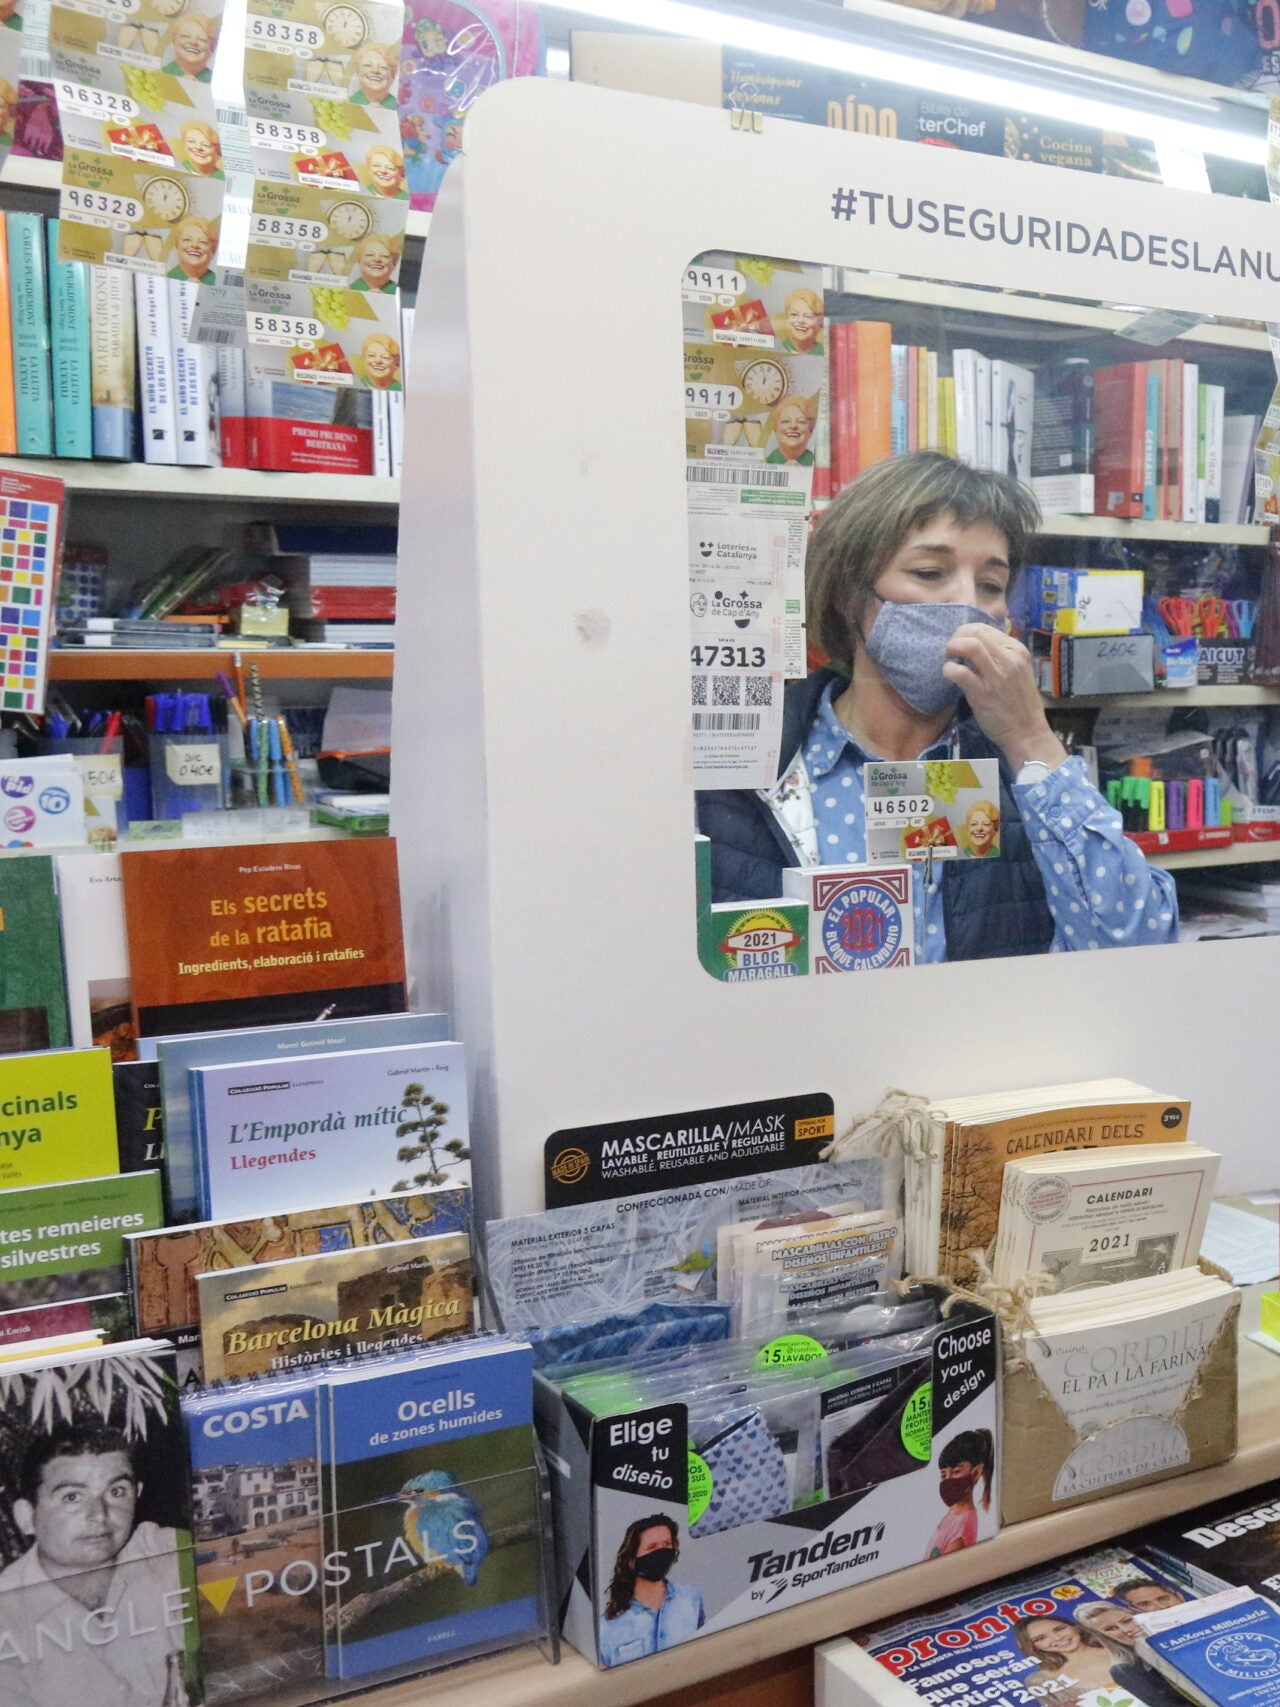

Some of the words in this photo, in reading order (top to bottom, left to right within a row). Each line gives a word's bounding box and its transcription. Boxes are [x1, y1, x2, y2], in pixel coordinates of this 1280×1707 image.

[252, 20, 318, 46] 58358
[62, 84, 133, 114] 96328
[257, 96, 292, 109] Grossa
[255, 122, 320, 144] 58358
[917, 116, 987, 138] terChef
[1039, 136, 1093, 155] Cocina
[1039, 152, 1093, 169] vegana
[68, 190, 137, 218] 96328
[257, 218, 321, 239] 58358
[24, 266, 35, 327] PUIGDEMONT
[66, 270, 76, 331] PUIGDEMONT
[254, 317, 318, 336] 58358
[716, 551, 758, 561] Catalunya
[711, 609, 721, 617] de
[722, 609, 738, 619] Cap
[738, 608, 761, 620] d'Any
[722, 597, 763, 610] Grossa
[690, 645, 767, 668] 47313
[1198, 648, 1246, 665] AICUT
[873, 799, 930, 814] 46502
[210, 899, 239, 917] Els
[243, 887, 329, 915] secrets
[827, 906, 844, 923] EL
[841, 889, 896, 919] POPULAR
[209, 931, 231, 949] de
[235, 929, 250, 946] la
[255, 916, 334, 945] ratafia
[743, 931, 777, 948] 2021
[840, 906, 885, 953] 2021
[177, 956, 253, 976] Ingredients,
[252, 950, 314, 969] elaboració
[315, 951, 322, 963] i
[322, 948, 366, 964] ratafies
[742, 948, 780, 966] BLOC
[825, 931, 854, 968] BLOQUE
[853, 925, 899, 971] CALENDARIO
[727, 964, 795, 983] MARAGALL
[1, 1091, 79, 1117] cinals
[228, 1110, 347, 1145] L'Empordà
[354, 1104, 408, 1129] mític
[601, 1114, 786, 1158] MASCARILLA/MASK
[797, 1124, 826, 1138] SPORT
[602, 1153, 648, 1170] LAVABLE
[656, 1142, 720, 1160] REUTILIZABLE
[721, 1139, 729, 1150] Y
[730, 1131, 786, 1150] REGULABLE
[1006, 1126, 1094, 1155] CALENDARI
[1101, 1123, 1145, 1142] DELS
[230, 1147, 318, 1171] Llegendes
[659, 1155, 706, 1172] REUSABLE
[706, 1150, 729, 1165] AND
[730, 1141, 786, 1161] ADJUSTABLE
[738, 1194, 771, 1206] MATERIAL
[771, 1189, 800, 1201] INTERIOR
[1086, 1186, 1154, 1206] CALENDARI
[0, 1226, 31, 1245] tes
[37, 1210, 145, 1240] remeieres
[510, 1234, 547, 1248] MATERIAL
[548, 1229, 583, 1241] EXTERIOR
[589, 1222, 616, 1234] CAPAS
[0, 1241, 102, 1269] silvestres
[771, 1238, 843, 1261] MASCARILLAS
[844, 1233, 867, 1249] CON
[867, 1226, 899, 1243] FILTRO
[1088, 1233, 1132, 1253] 2021
[783, 1252, 829, 1270] DISEÑOS
[225, 1316, 359, 1357] Barcelona
[368, 1297, 461, 1332] Màgica
[271, 1347, 343, 1371] Històries
[345, 1344, 354, 1358] i
[356, 1332, 424, 1354] llegendes
[763, 1348, 782, 1364] 15
[782, 1352, 823, 1363] LAVADOS
[936, 1327, 993, 1361] Choose
[940, 1358, 975, 1384] your
[1061, 1378, 1082, 1395] EL
[1087, 1373, 1109, 1391] PA
[1113, 1371, 1121, 1384] I
[1125, 1365, 1145, 1383] LA
[1150, 1345, 1211, 1376] FARINA
[942, 1368, 987, 1411] design
[203, 1399, 310, 1437] COSTA
[397, 1389, 477, 1423] Ocells
[911, 1396, 927, 1413] 15
[369, 1431, 389, 1448] de
[391, 1421, 436, 1444] zones
[437, 1407, 504, 1433] humides
[609, 1414, 674, 1448] Elige
[651, 1445, 670, 1463] tu
[612, 1463, 675, 1490] diseño
[691, 1473, 706, 1483] SUS
[1063, 1481, 1079, 1495] LA
[1079, 1466, 1133, 1490] CULTURA
[1135, 1461, 1149, 1474] DE
[1151, 1452, 1182, 1470] CASA
[245, 1519, 479, 1609] POSTALS
[747, 1521, 886, 1585] Tandem
[750, 1588, 766, 1603] by
[790, 1547, 880, 1591] SporTandem
[874, 1597, 1058, 1678] pronto
[1209, 1633, 1263, 1657] L'ANXOVA
[904, 1649, 1016, 1692] Famosos
[921, 1681, 971, 1704] que
[970, 1654, 1043, 1686] serán
[1012, 1673, 1081, 1704] 2021
